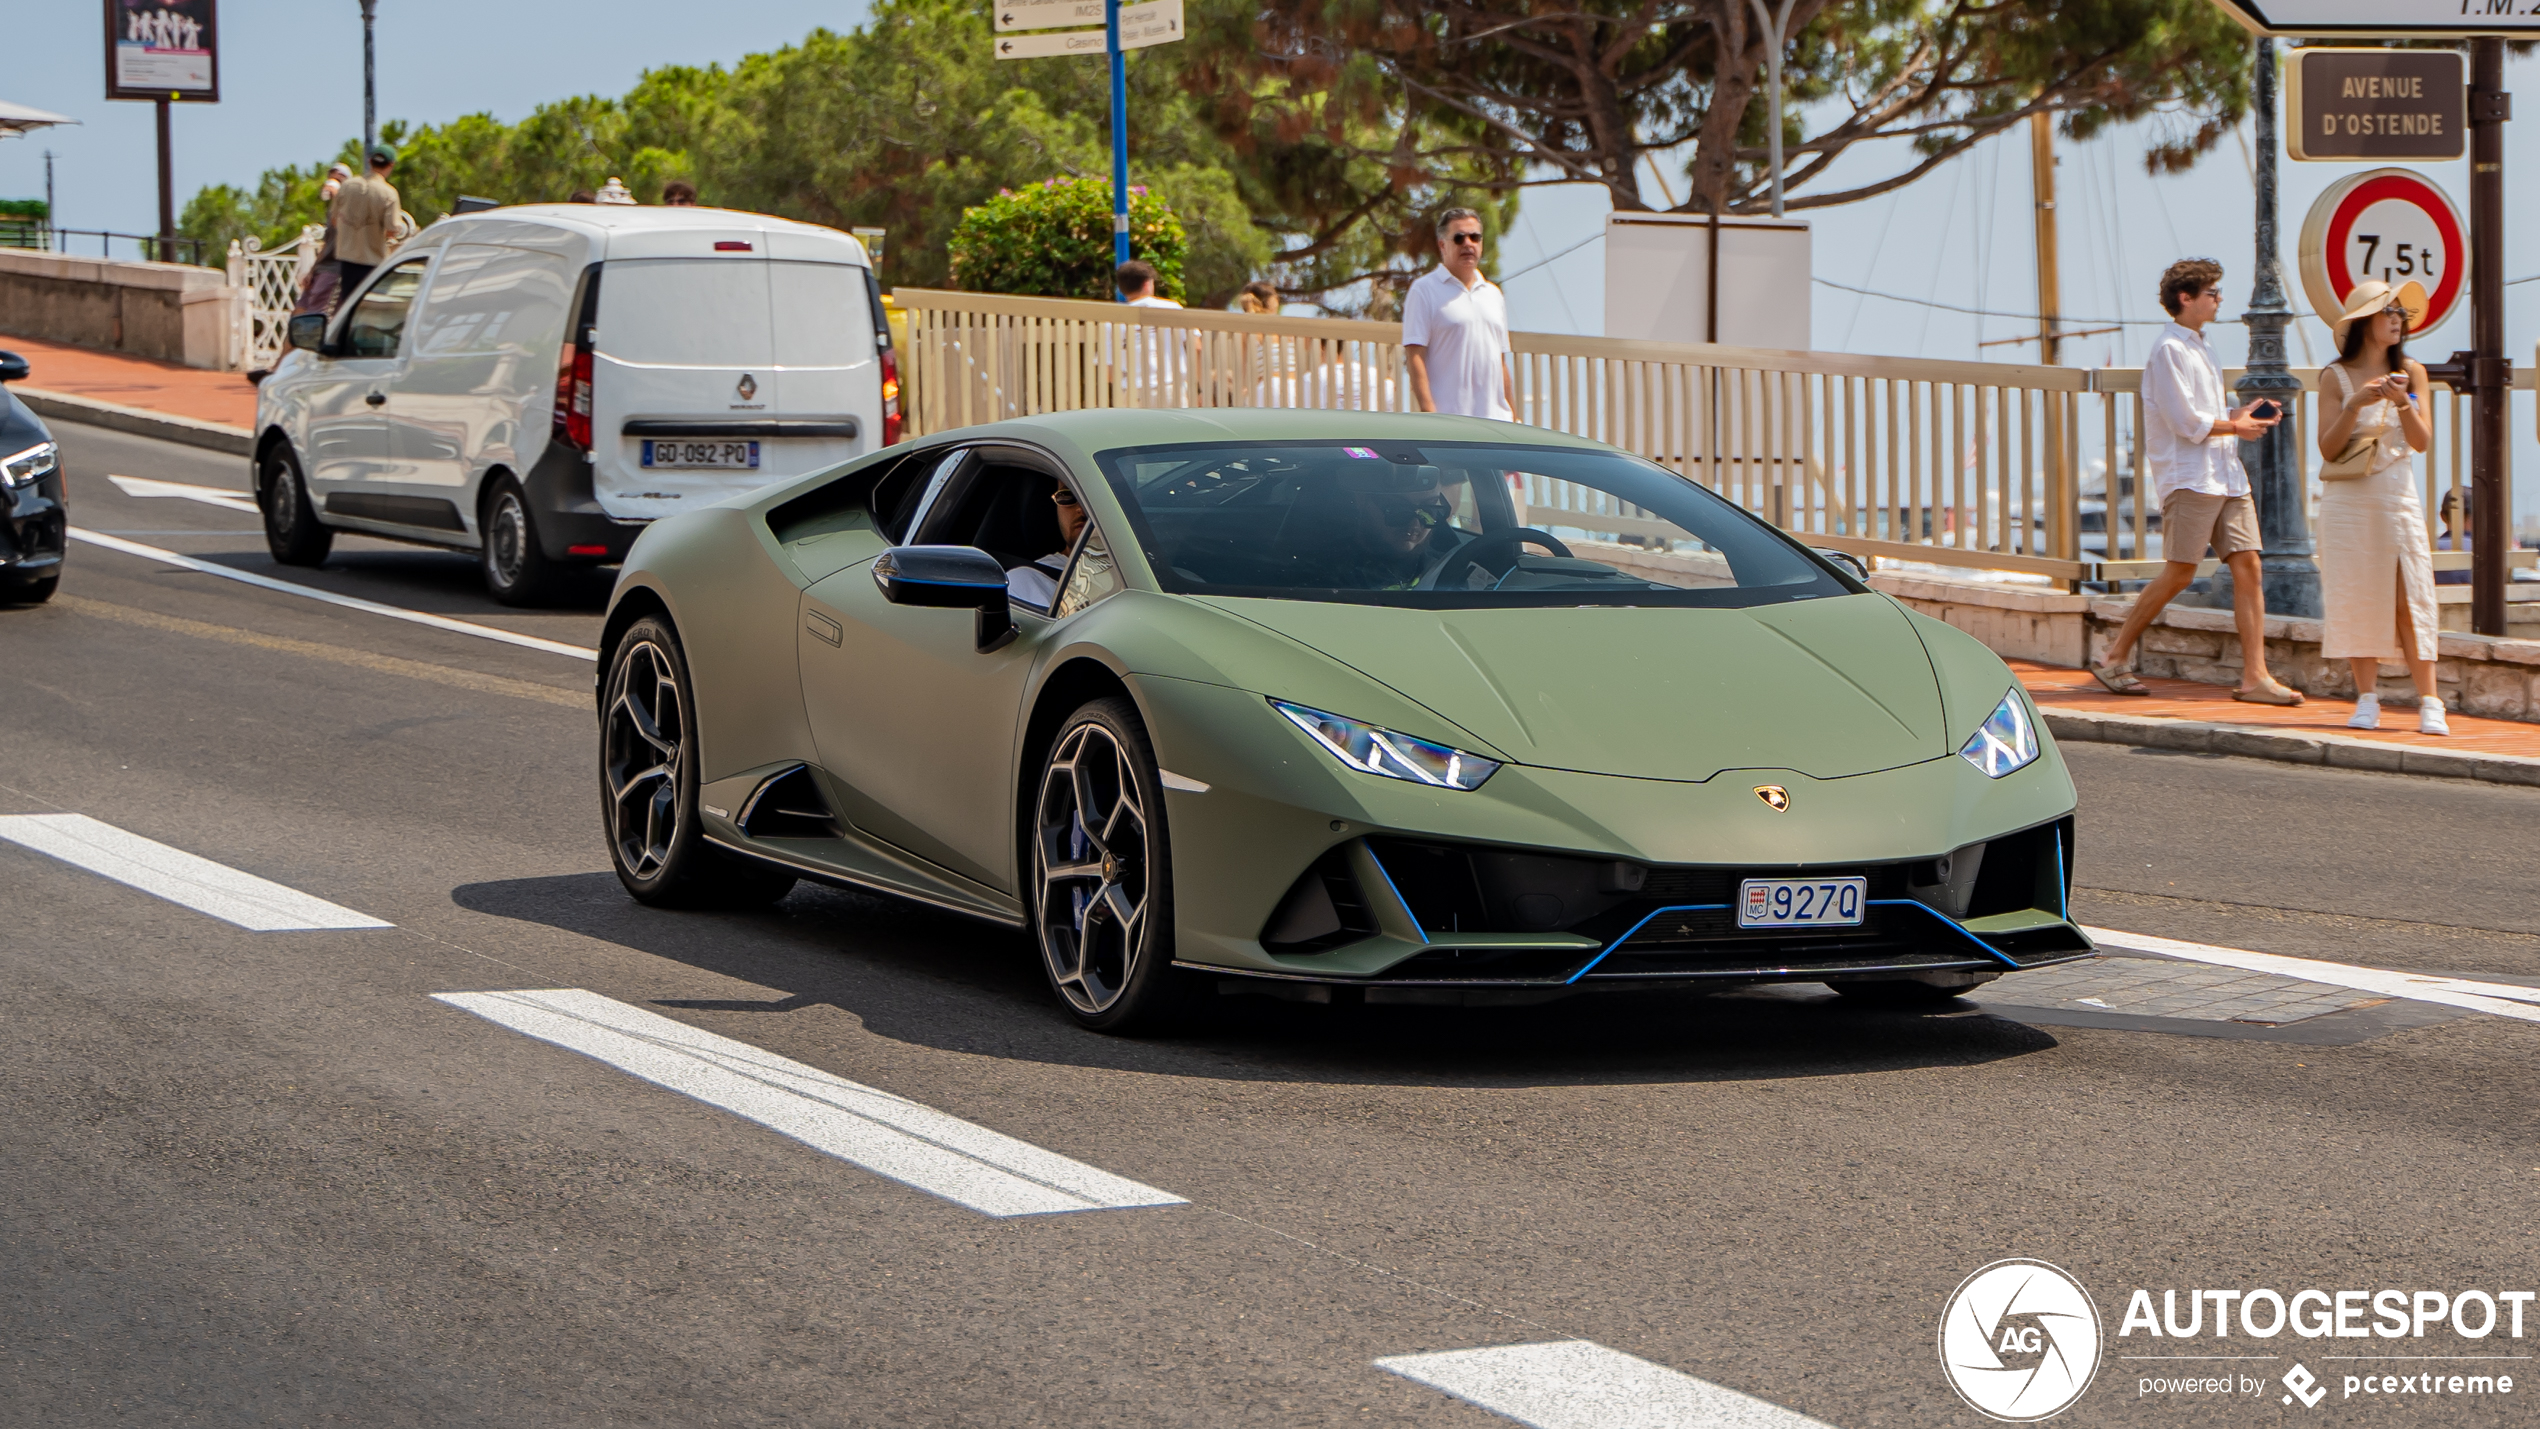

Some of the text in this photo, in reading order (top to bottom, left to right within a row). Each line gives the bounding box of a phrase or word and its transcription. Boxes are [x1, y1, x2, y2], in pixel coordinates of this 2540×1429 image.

[1075, 5, 1102, 17] IM2S
[1066, 37, 1103, 49] Casino
[2342, 77, 2423, 99] AVENUE
[2323, 114, 2443, 136] D'OSTENDE
[1750, 905, 1764, 914] MC
[1774, 884, 1858, 919] 927Q
